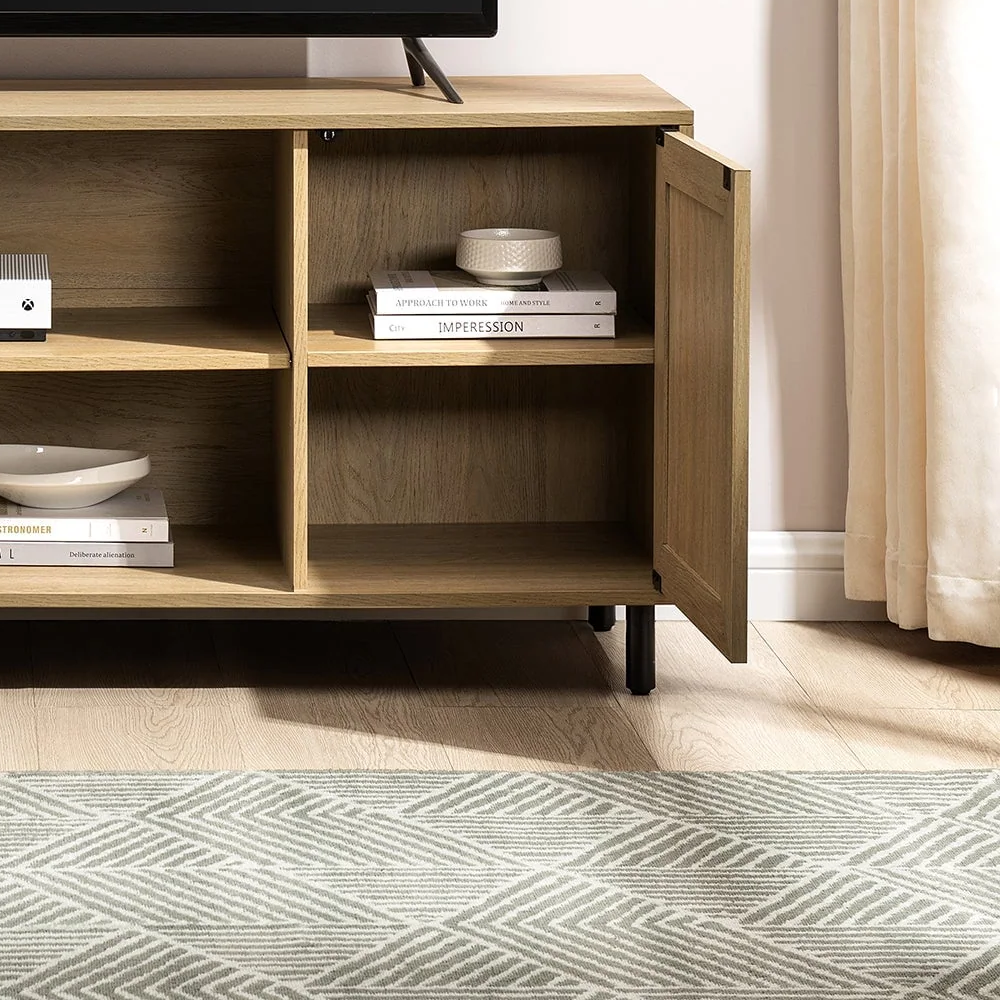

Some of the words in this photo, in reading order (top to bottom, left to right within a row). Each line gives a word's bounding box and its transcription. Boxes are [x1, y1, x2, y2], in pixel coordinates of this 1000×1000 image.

[395, 299, 444, 307] APPROACH
[445, 299, 458, 307] TO
[459, 299, 488, 307] WORK
[438, 321, 524, 333] IMPERESSION
